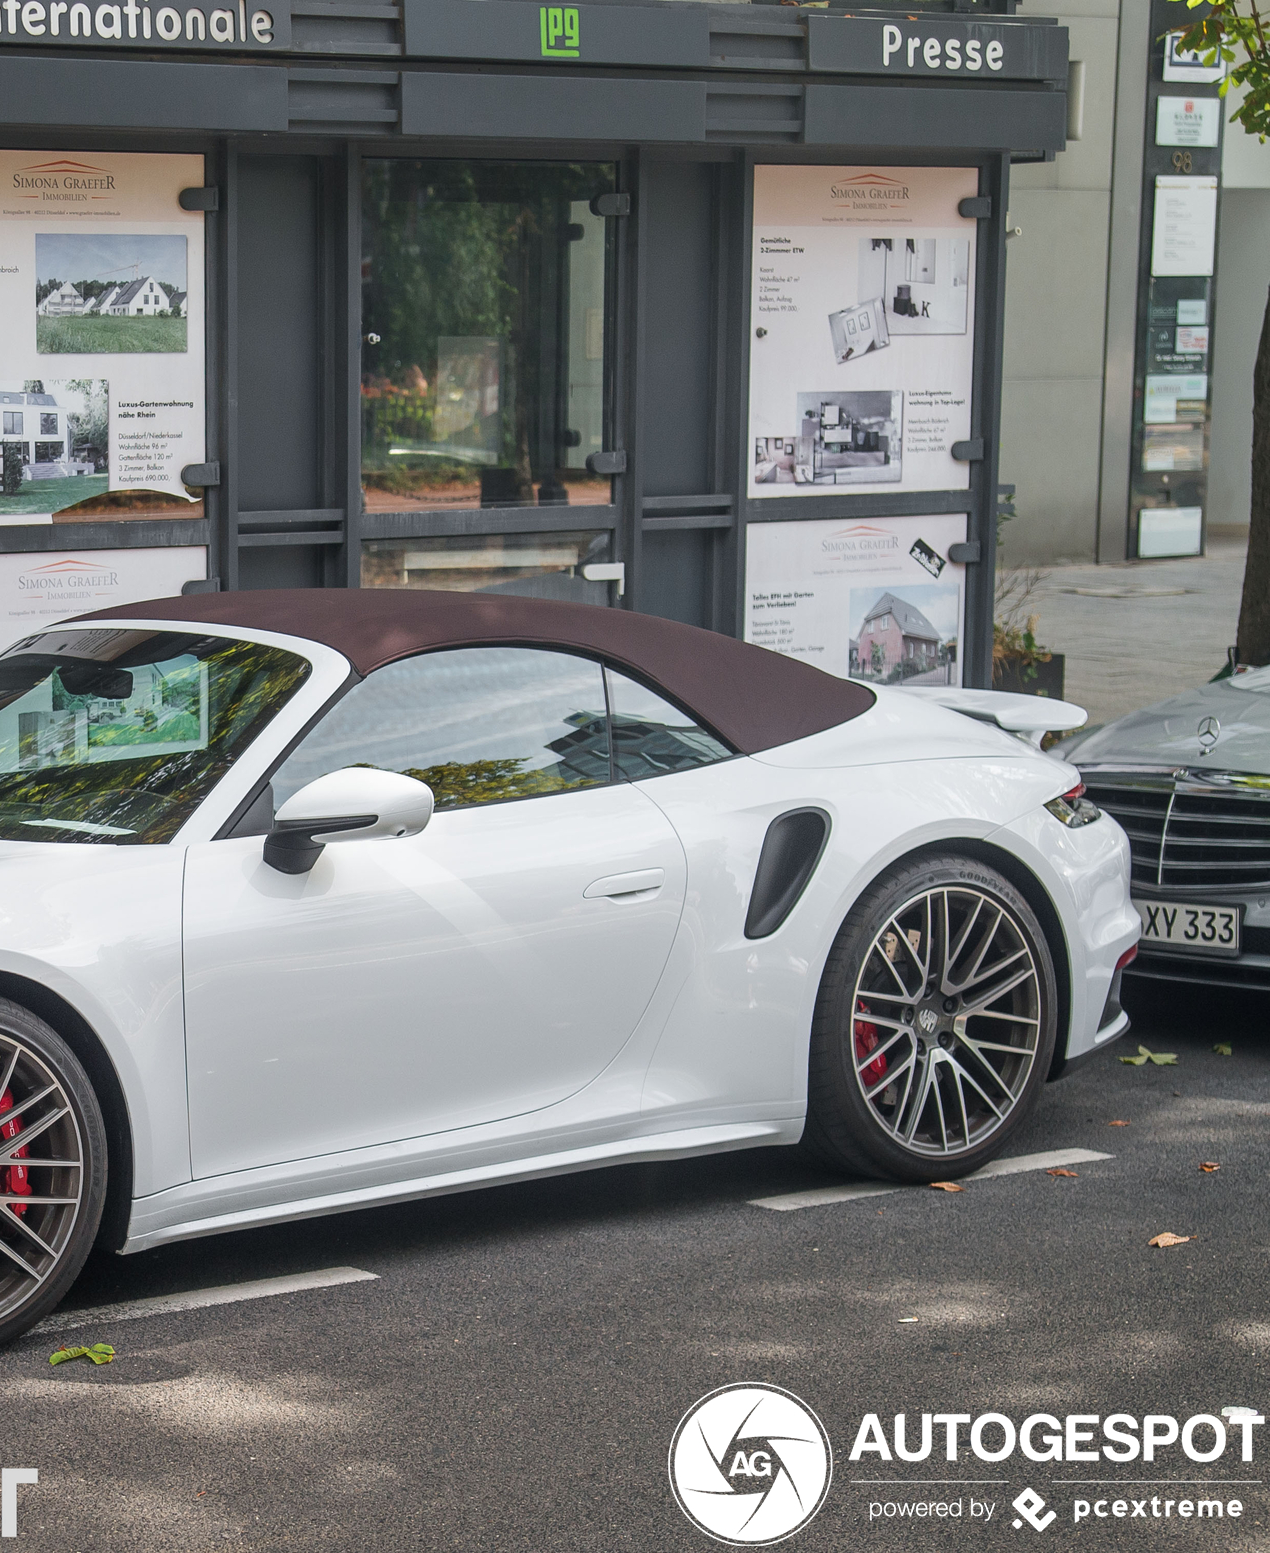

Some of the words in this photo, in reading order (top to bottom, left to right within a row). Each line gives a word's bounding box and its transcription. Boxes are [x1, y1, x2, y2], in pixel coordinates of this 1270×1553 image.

[883, 24, 1004, 71] Presse
[1171, 151, 1193, 174] 98
[13, 174, 59, 189] SIMONA
[63, 175, 116, 190] GRAEFER
[42, 192, 88, 201] IMMOBILIEN
[831, 186, 866, 199] SIMONA
[869, 186, 910, 200] GRAEFER
[852, 202, 888, 210] IMMOBILIEN
[760, 237, 791, 245] Gemütliche
[118, 400, 194, 409] Luxus-Gartenwohnung
[118, 431, 184, 441] Düsseldorf/Niederkassel
[118, 442, 151, 451] Wohnfläche
[124, 464, 145, 473] Zimmer,
[146, 463, 165, 471] Balkon
[118, 475, 144, 484] Kaufpreis
[822, 540, 856, 553] SIMONA
[859, 537, 899, 550] GRAEFER
[18, 576, 63, 590] SIMONA
[68, 572, 119, 588] GRAEFER
[47, 591, 91, 600] IMMOBILIEN
[1145, 905, 1178, 938] XY
[1183, 909, 1234, 943] 333
